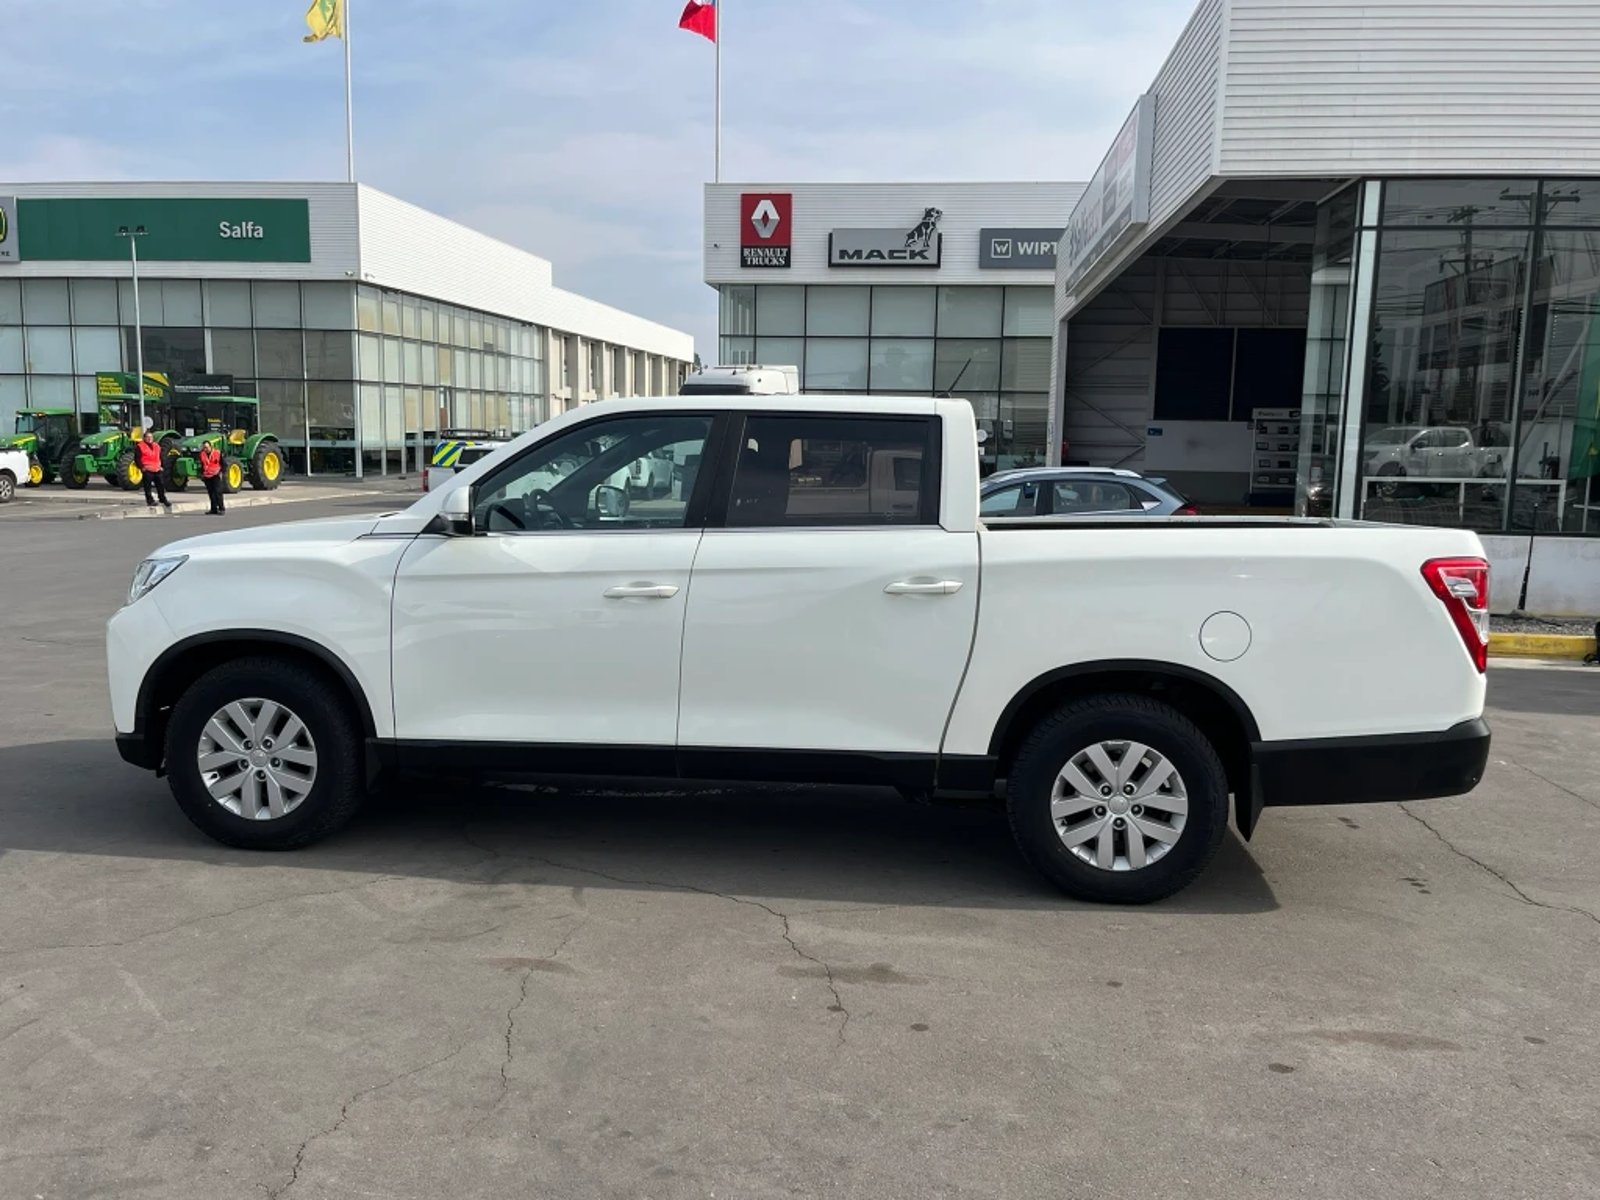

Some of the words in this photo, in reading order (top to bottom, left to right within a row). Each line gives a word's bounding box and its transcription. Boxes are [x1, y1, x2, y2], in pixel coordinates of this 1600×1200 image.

[219, 221, 264, 238] Salfa
[743, 247, 789, 257] RENAULT
[838, 249, 930, 260] MACK
[745, 256, 786, 266] TRUCKS
